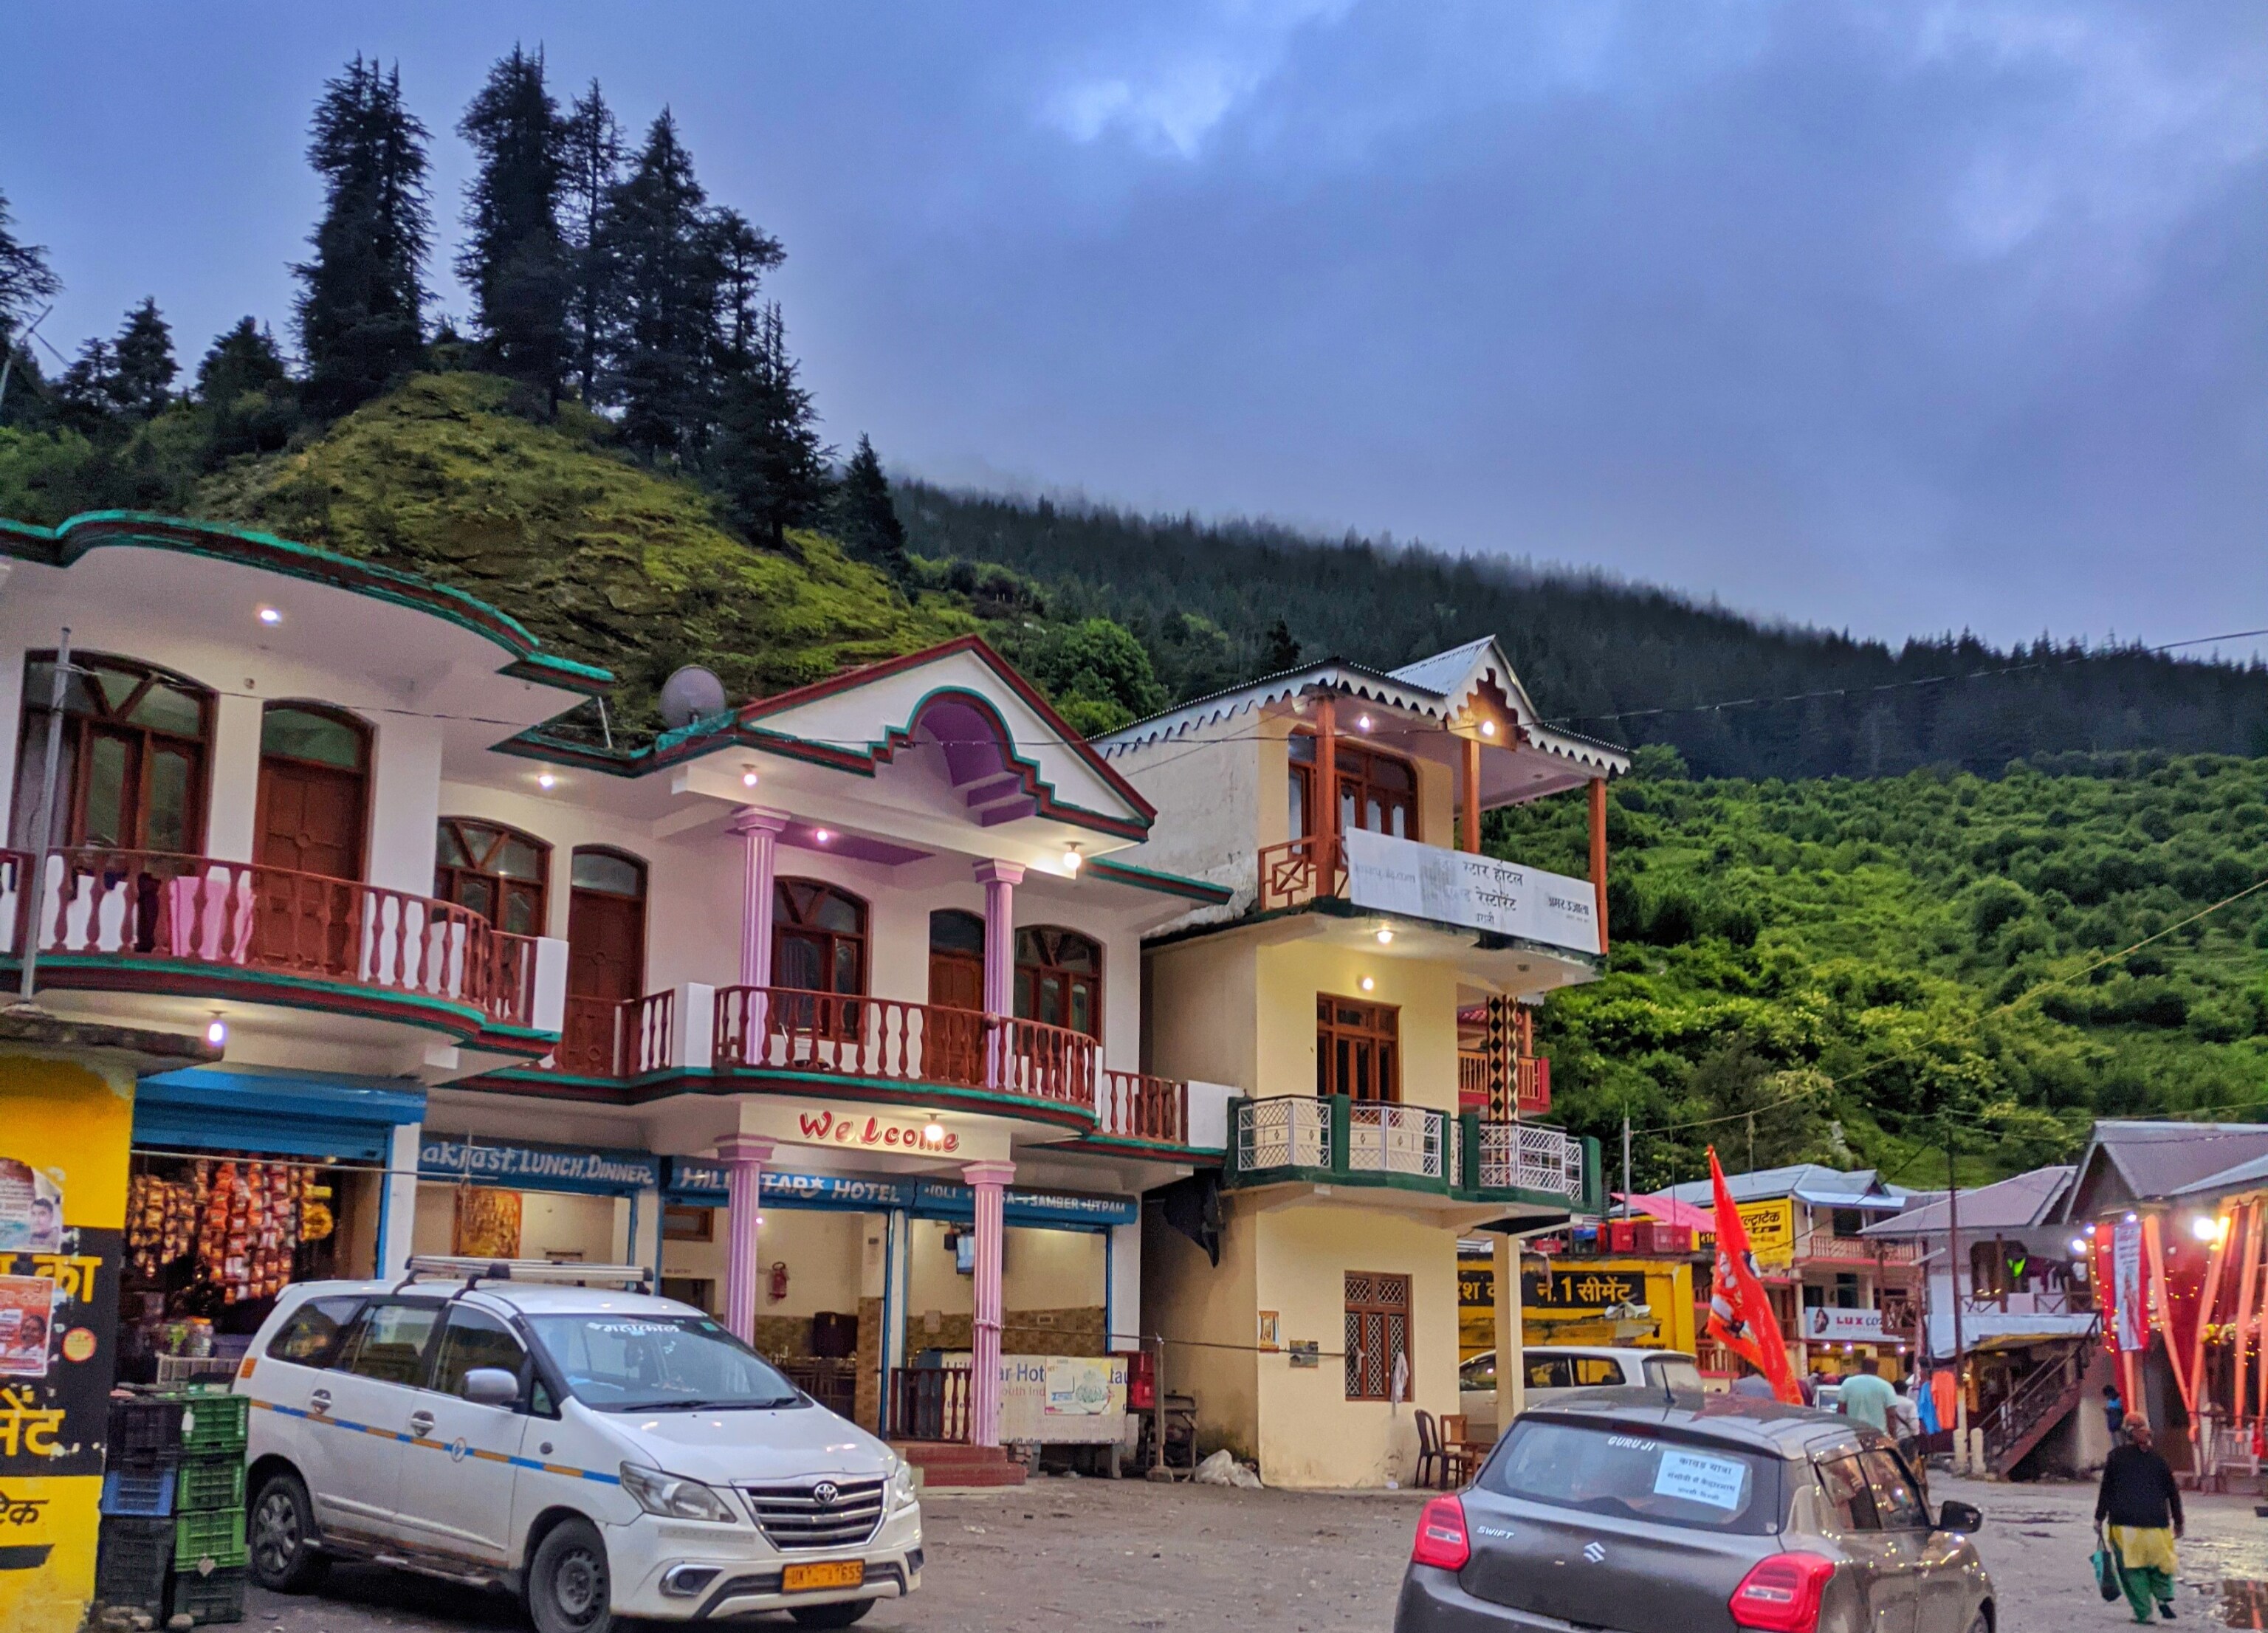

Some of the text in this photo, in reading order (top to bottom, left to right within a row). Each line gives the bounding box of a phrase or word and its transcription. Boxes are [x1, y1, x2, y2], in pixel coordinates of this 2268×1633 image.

[832, 1179, 901, 1203] HOTEL
[1575, 1276, 1632, 1303] सीमेंट
[1836, 1316, 1863, 1325] LUX
[1017, 1363, 1045, 1383] Hot
[1608, 1436, 1656, 1452] GURU JI
[1477, 1525, 1514, 1539] SWIFT
